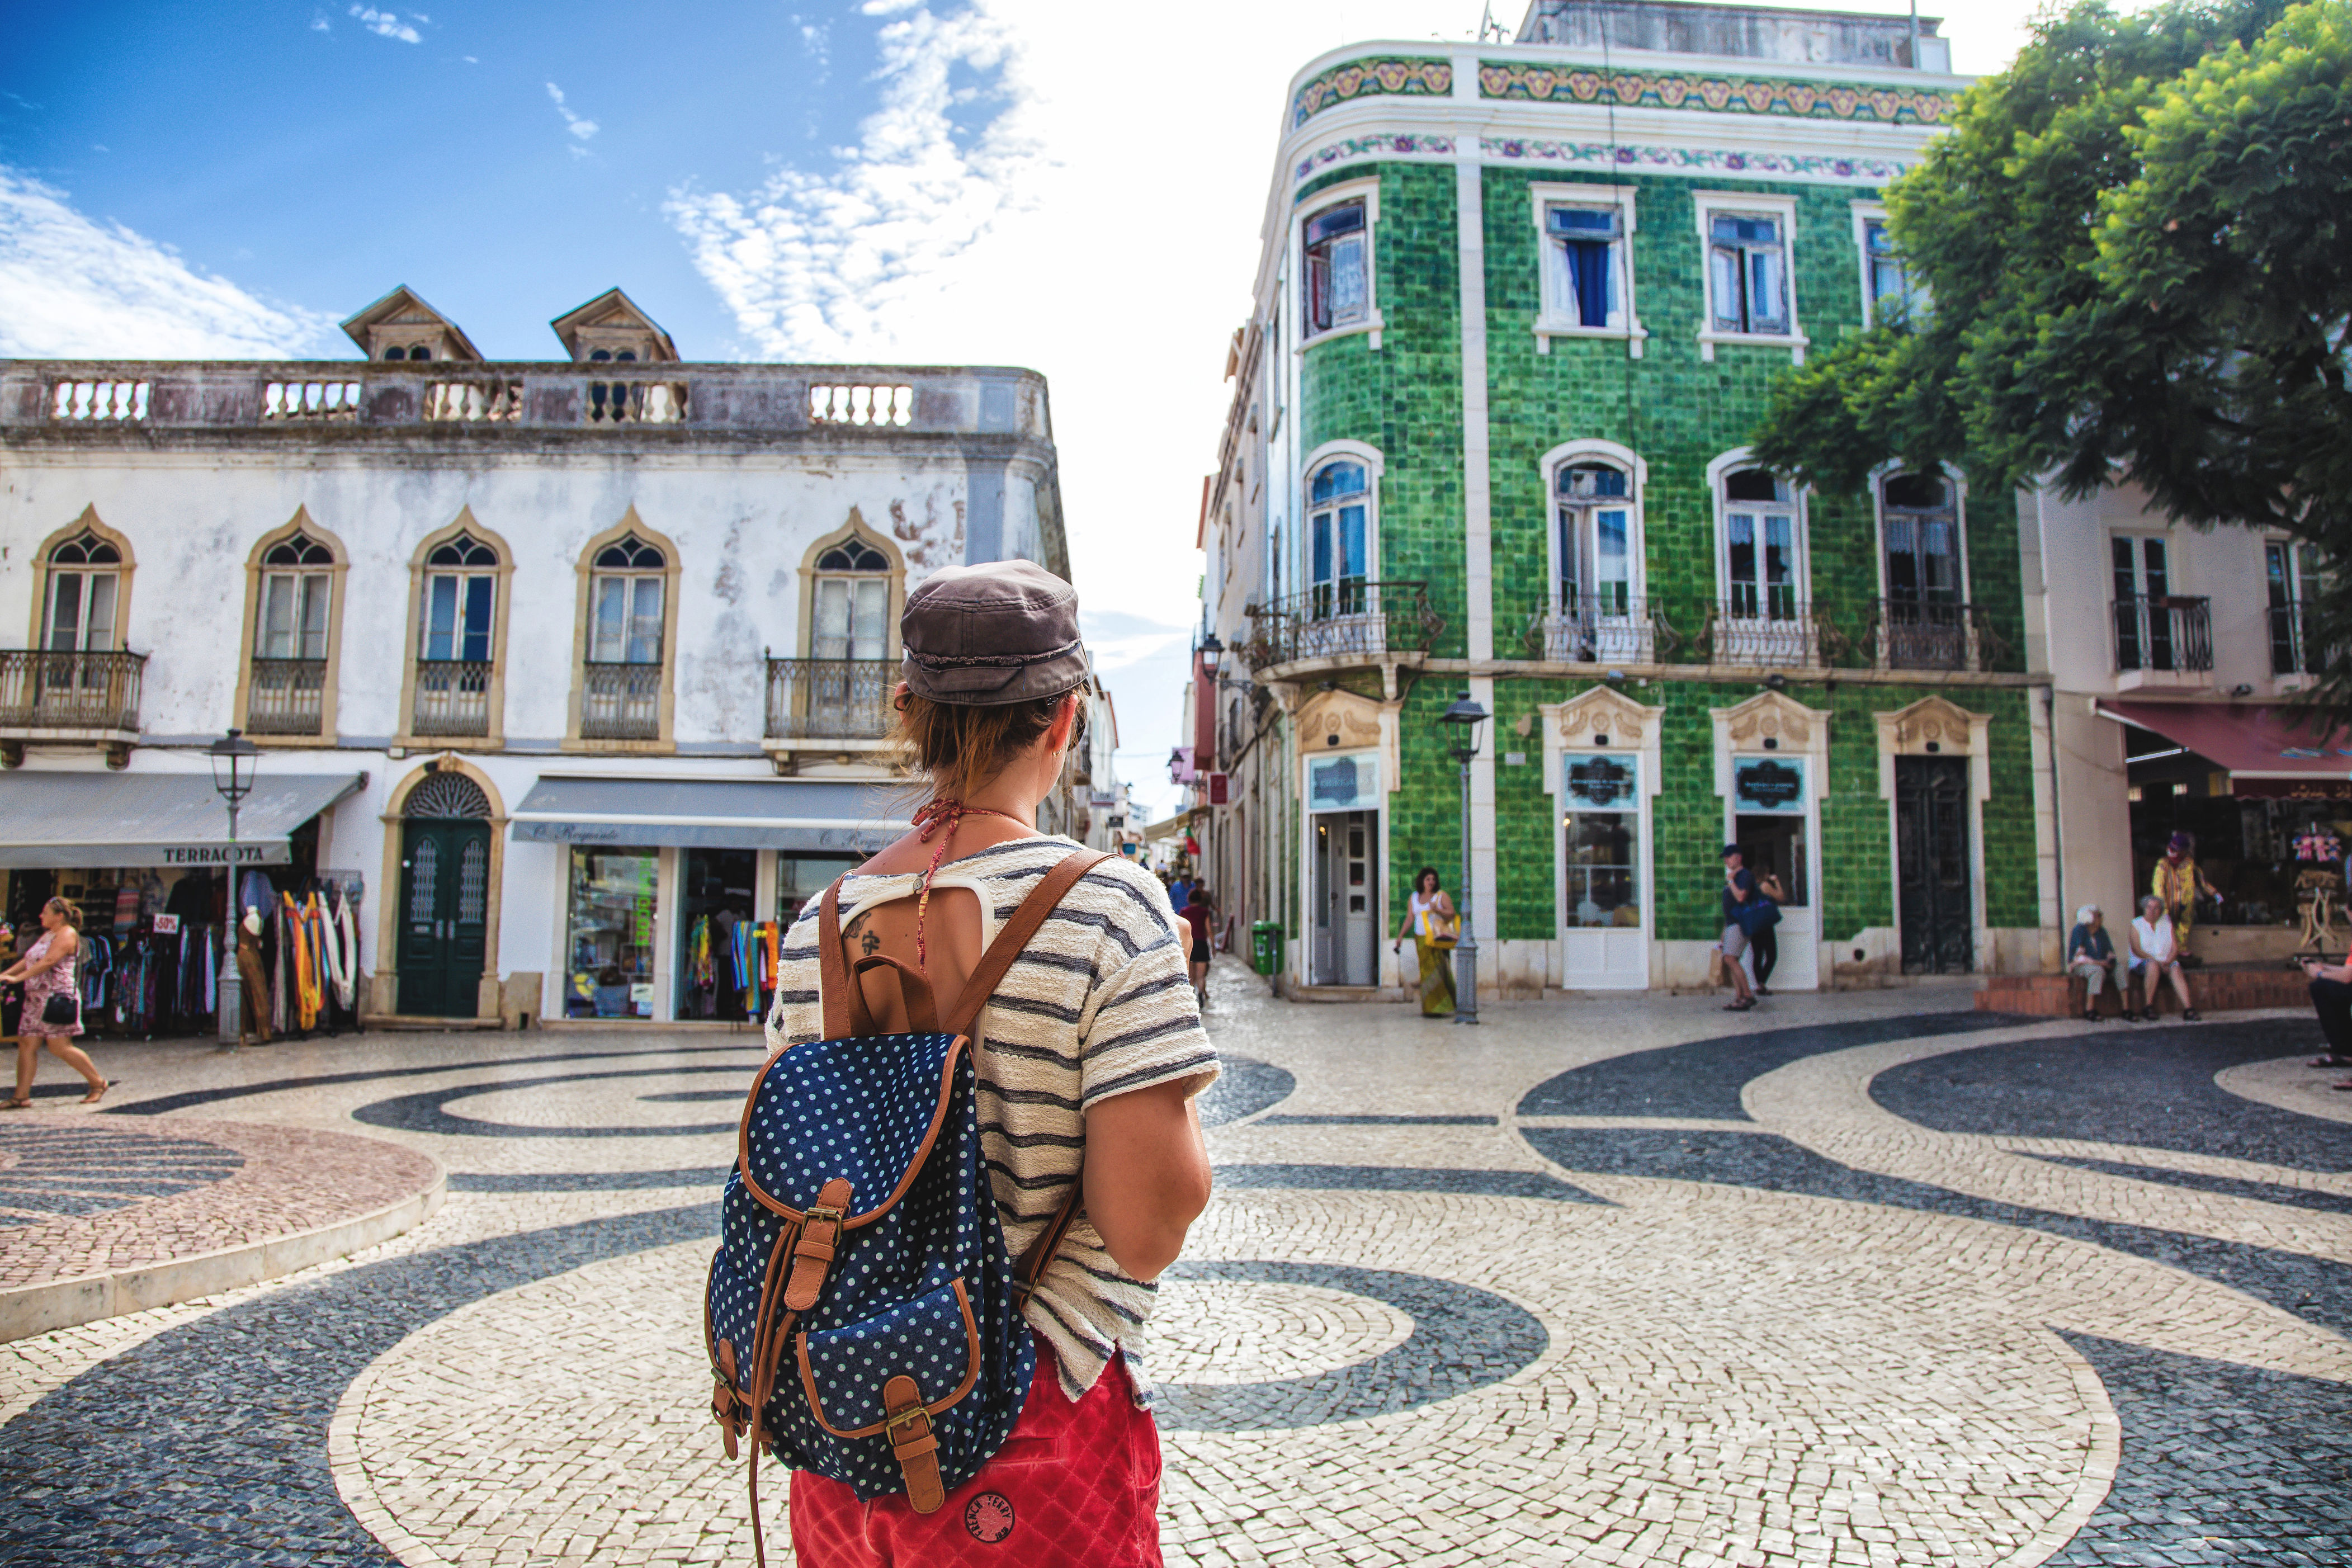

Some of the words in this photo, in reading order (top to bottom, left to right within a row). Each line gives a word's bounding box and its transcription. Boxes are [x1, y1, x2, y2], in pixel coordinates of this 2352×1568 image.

[164, 847, 263, 863] TERRACOTA
[968, 1500, 983, 1536] FRENCH
[987, 1495, 1011, 1518] TERRY
